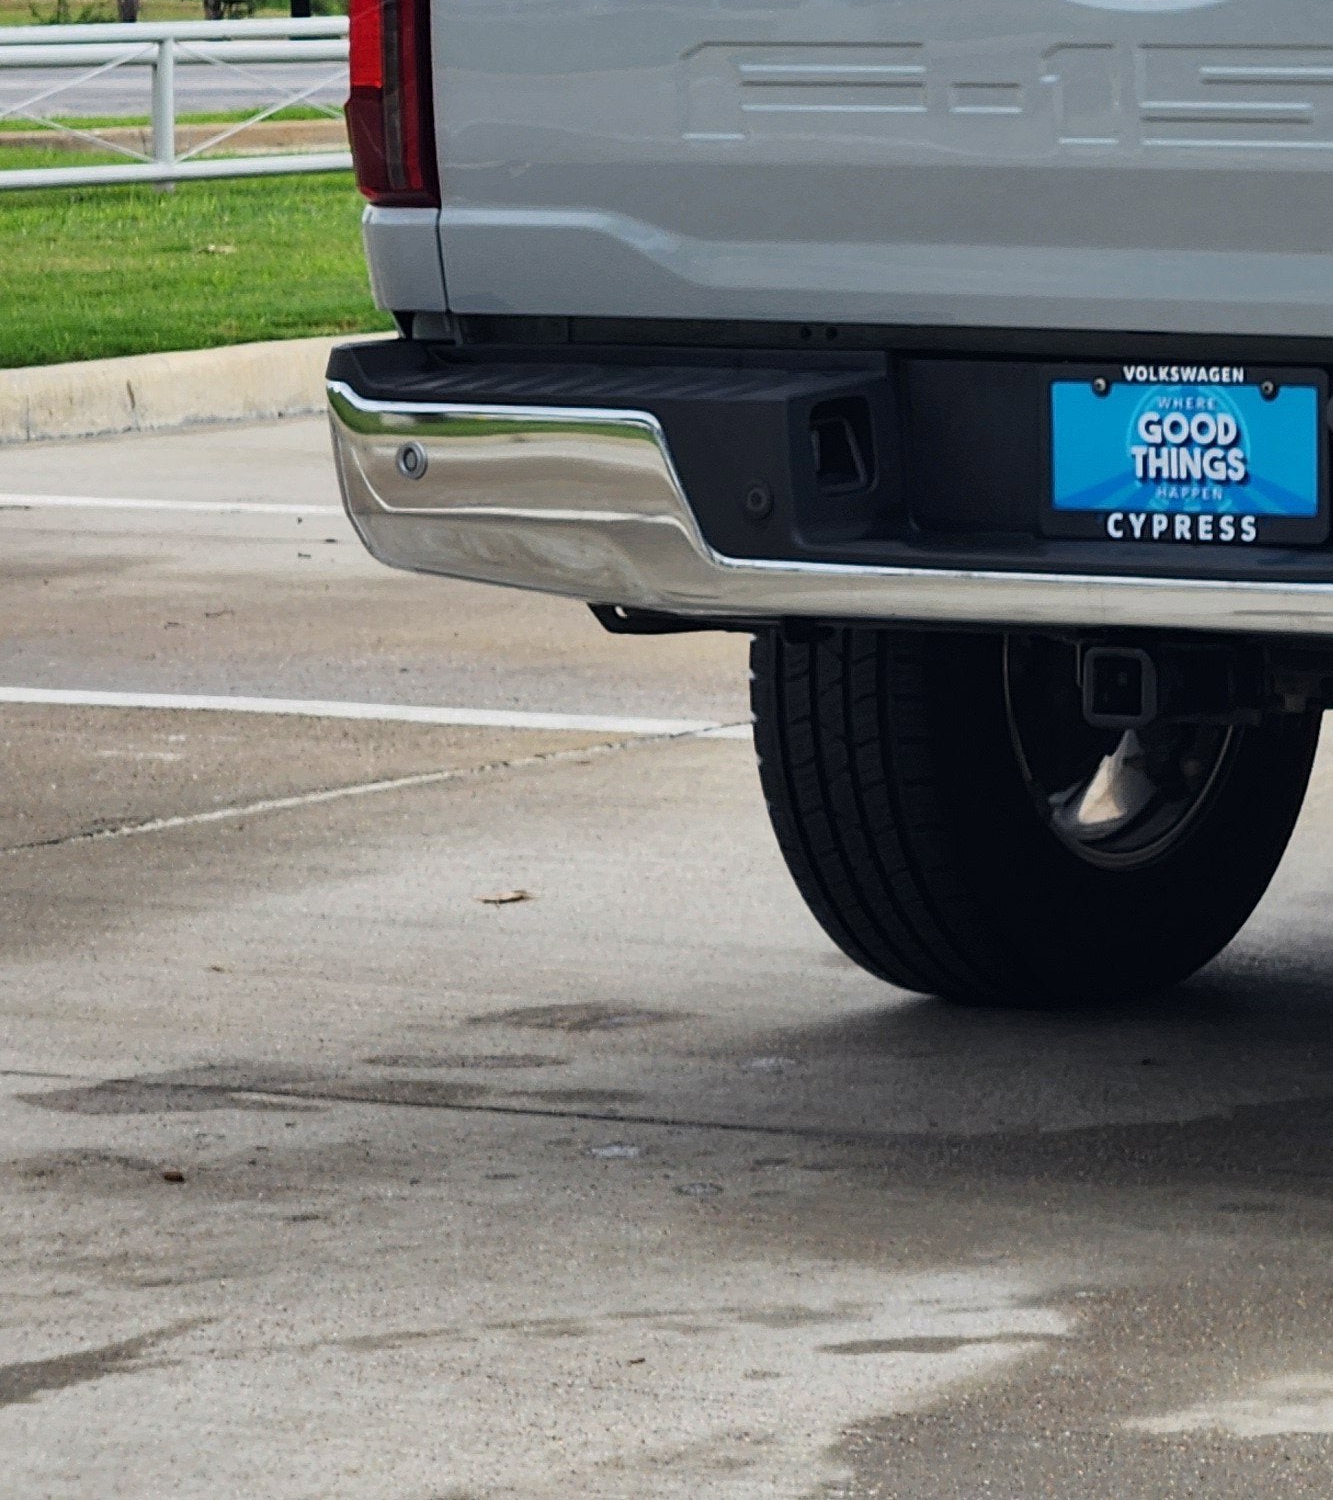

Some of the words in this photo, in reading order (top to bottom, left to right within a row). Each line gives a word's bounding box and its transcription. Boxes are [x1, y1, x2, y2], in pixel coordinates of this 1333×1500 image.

[1123, 365, 1244, 383] VOLKSWAGEN
[1158, 396, 1217, 411] WHERE
[1138, 411, 1238, 445] GOOD
[1131, 445, 1247, 481] THINGS
[1155, 486, 1224, 501] HAPPEN
[1107, 512, 1257, 542] CYPRESS
